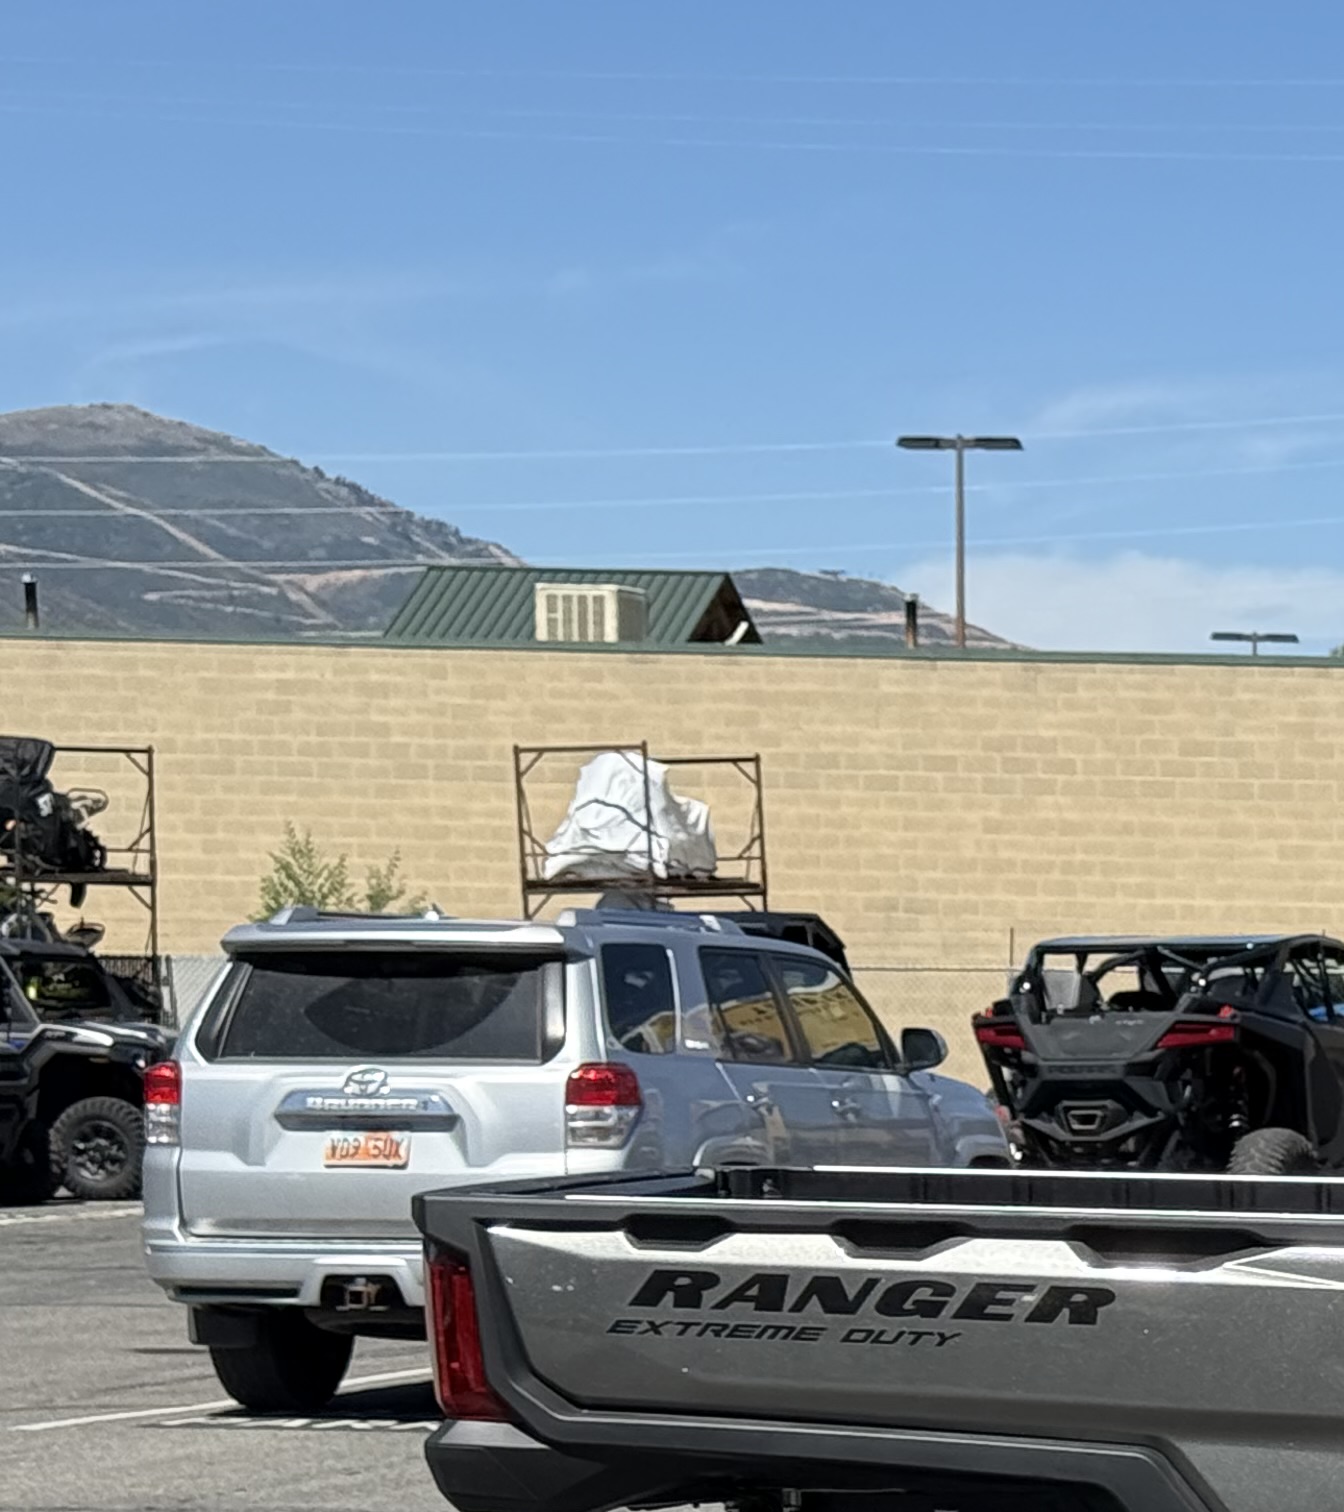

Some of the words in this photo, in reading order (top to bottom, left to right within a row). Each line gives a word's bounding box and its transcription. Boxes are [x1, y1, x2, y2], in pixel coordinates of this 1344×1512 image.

[628, 1268, 1117, 1326] RANGER
[606, 1319, 828, 1343] EXTREME
[839, 1327, 963, 1348] DUTY
